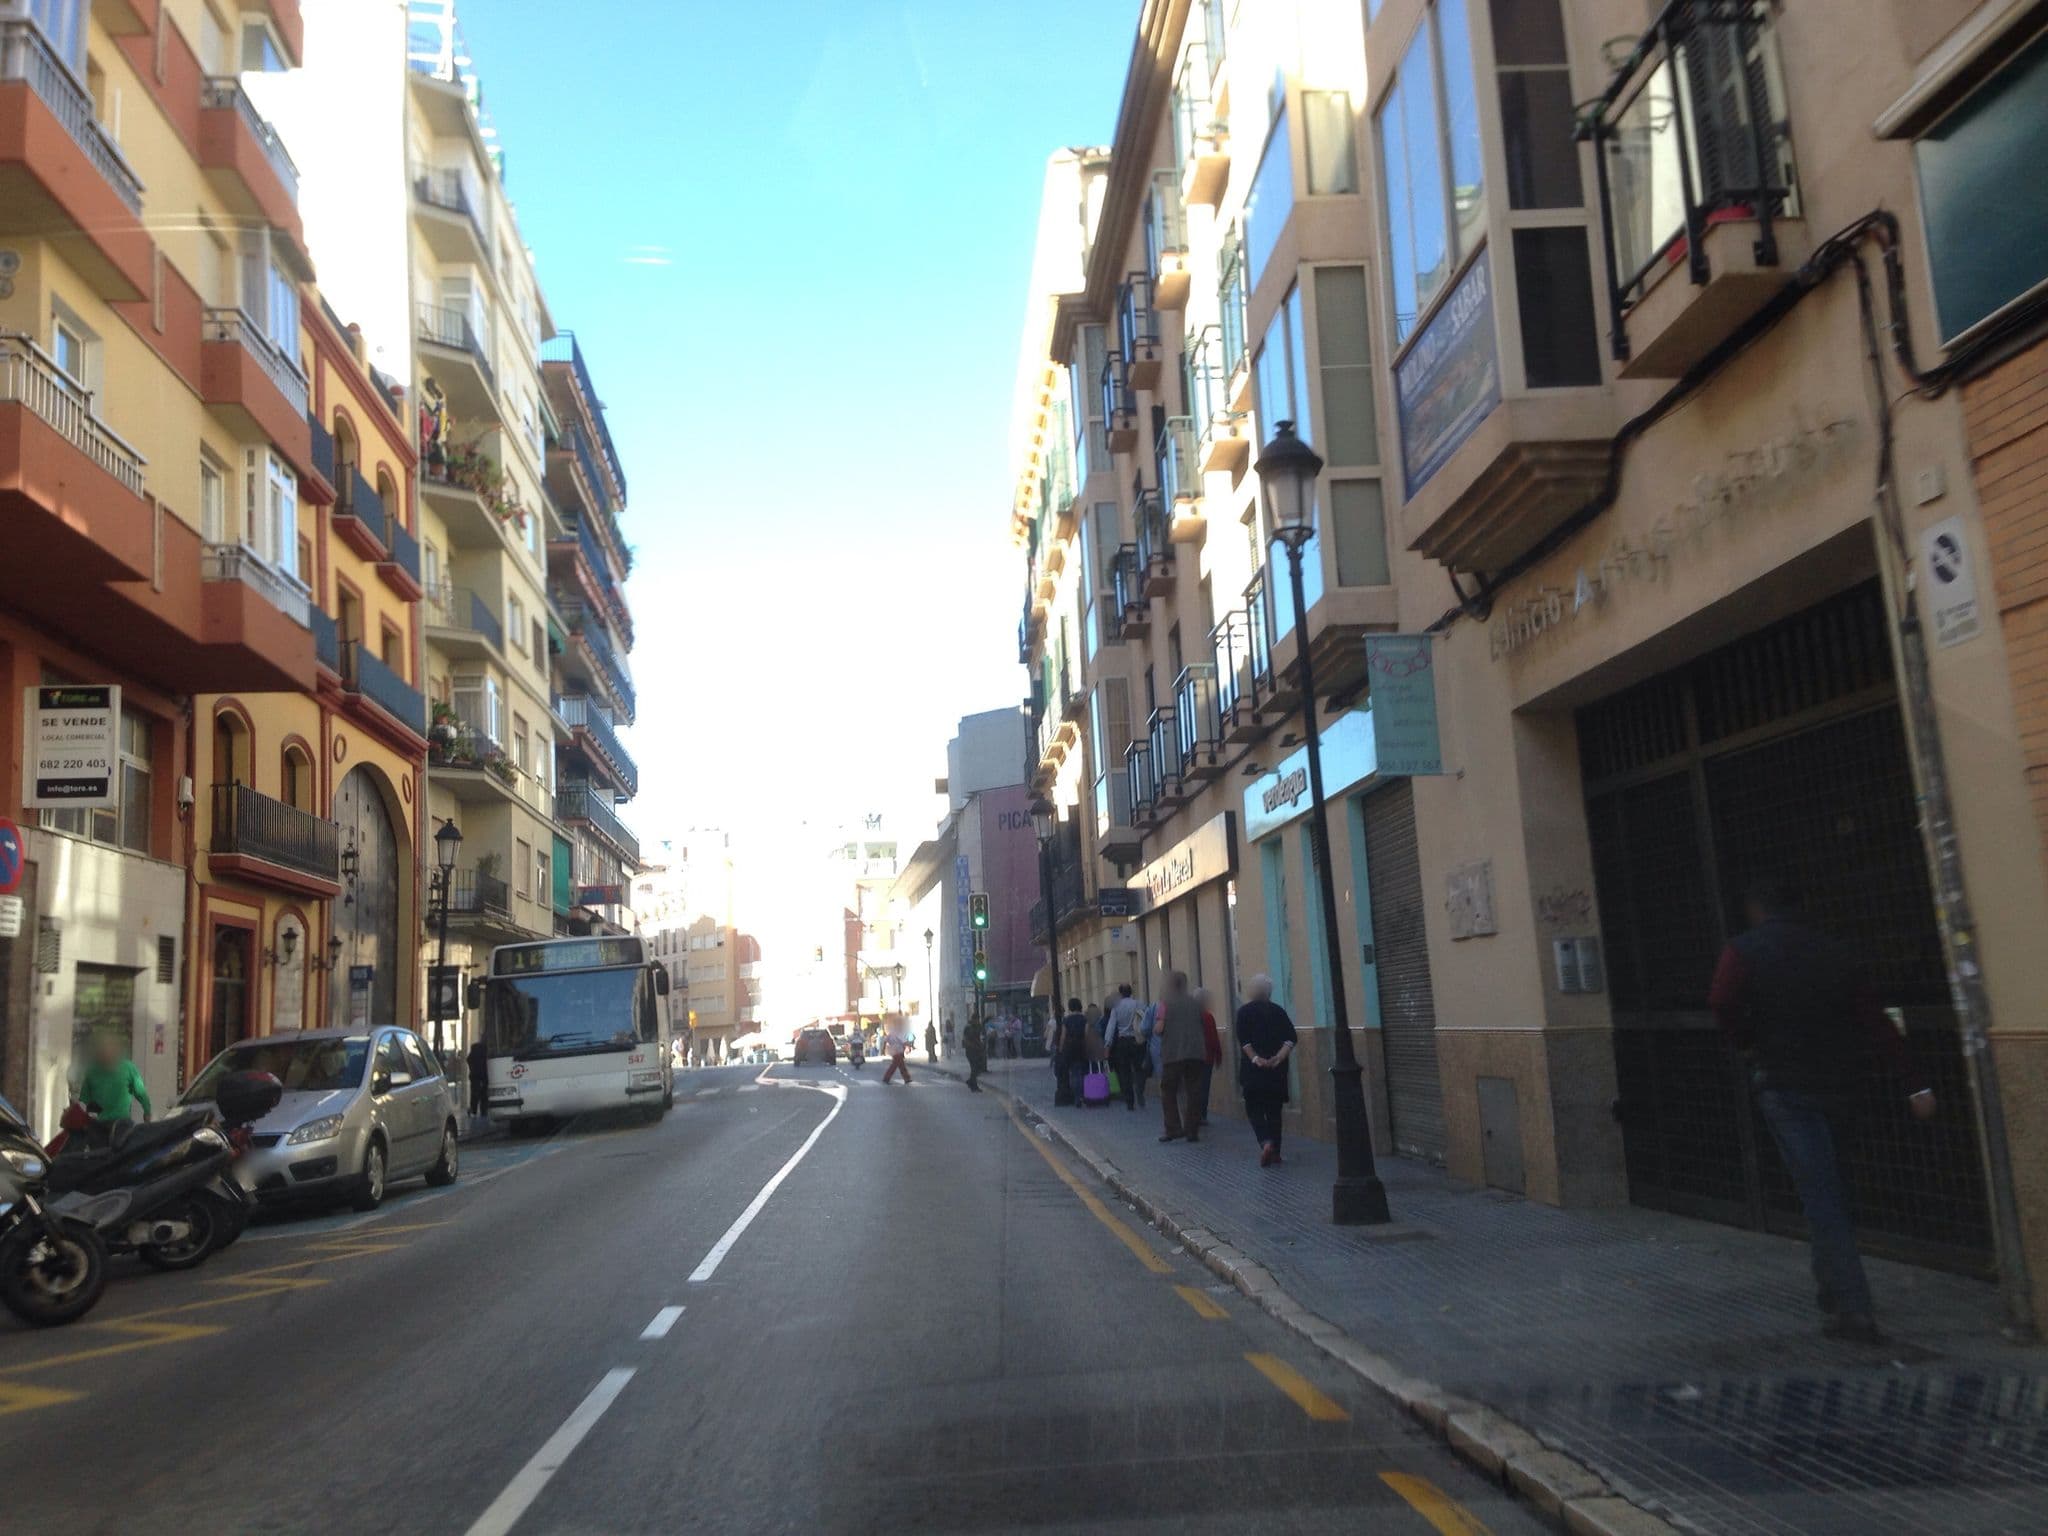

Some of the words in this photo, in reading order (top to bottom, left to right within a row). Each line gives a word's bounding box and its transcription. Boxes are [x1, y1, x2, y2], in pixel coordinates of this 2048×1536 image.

[42, 718, 57, 727] SE
[63, 717, 107, 726] VENDE
[40, 760, 60, 769] 682
[63, 760, 83, 769] 220
[86, 759, 106, 768] 403
